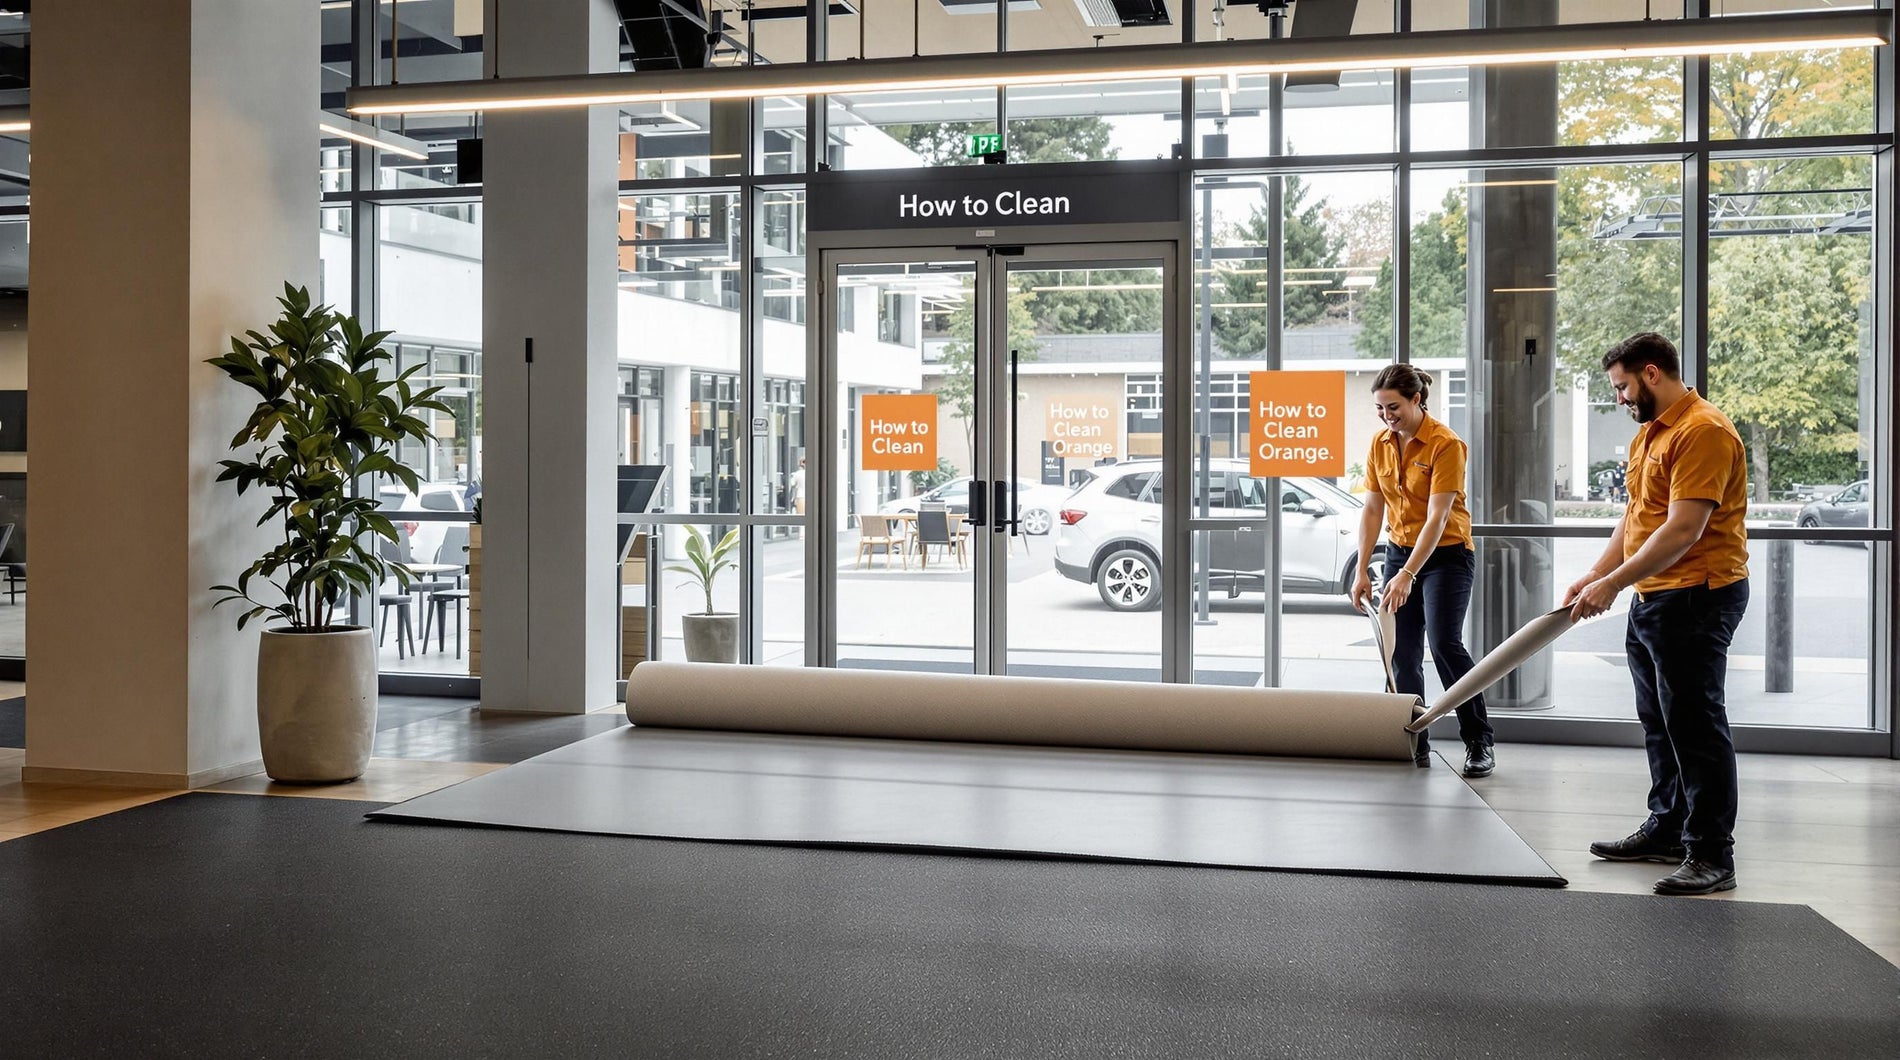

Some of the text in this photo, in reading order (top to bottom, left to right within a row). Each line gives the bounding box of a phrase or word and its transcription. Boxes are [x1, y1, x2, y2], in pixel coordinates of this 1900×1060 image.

[899, 190, 1070, 218] How to Clean
[1050, 402, 1109, 419] How to
[1259, 400, 1327, 418] How to
[870, 419, 929, 435] How to
[1053, 422, 1101, 437] Clean
[1263, 421, 1318, 439] Clean
[872, 437, 924, 454] Clean
[1052, 439, 1113, 457] Orange
[1258, 442, 1334, 464] Orange.
